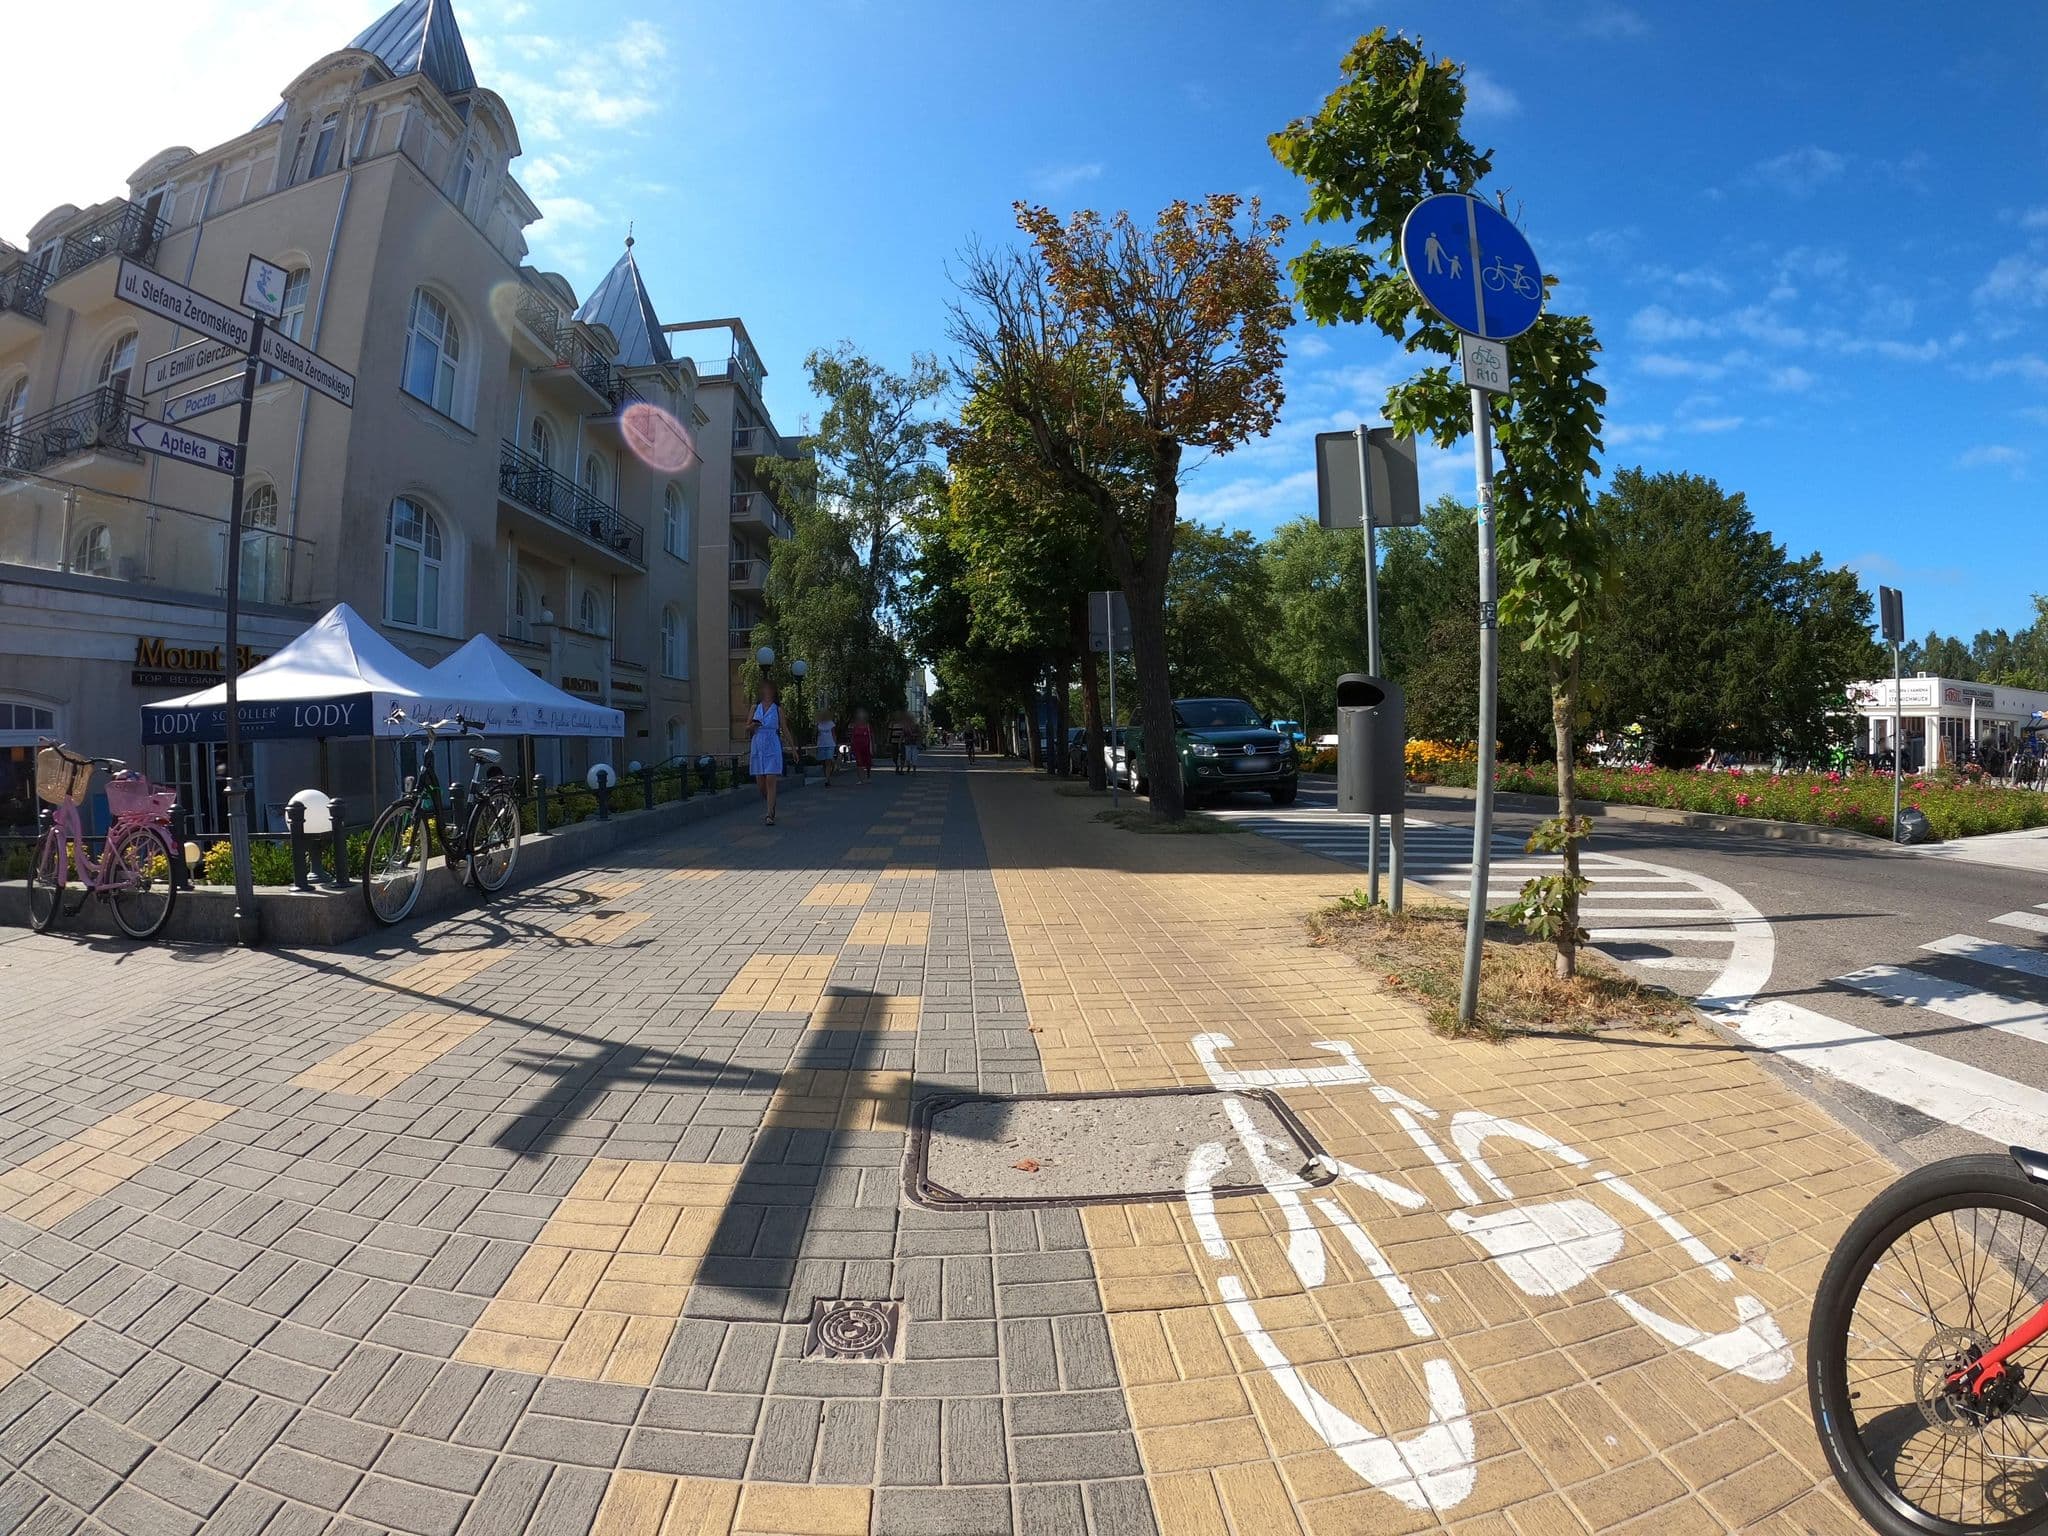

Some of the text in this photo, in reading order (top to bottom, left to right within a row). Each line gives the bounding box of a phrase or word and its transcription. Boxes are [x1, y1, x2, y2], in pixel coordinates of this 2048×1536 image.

[125, 275, 138, 294] ul.
[141, 279, 181, 313] Stefana
[184, 295, 248, 345] Żeromskiego
[157, 365, 167, 382] ul.
[170, 355, 195, 376] Emilii
[262, 338, 350, 399] ul. Stefana Żeromskiego
[1476, 368, 1498, 383] R10
[184, 392, 217, 413] Poczta
[160, 431, 207, 460] Apteka
[138, 637, 223, 670] Mount
[154, 712, 200, 735] LODY
[211, 707, 279, 721] SCÖLLER
[294, 703, 355, 727] LODY
